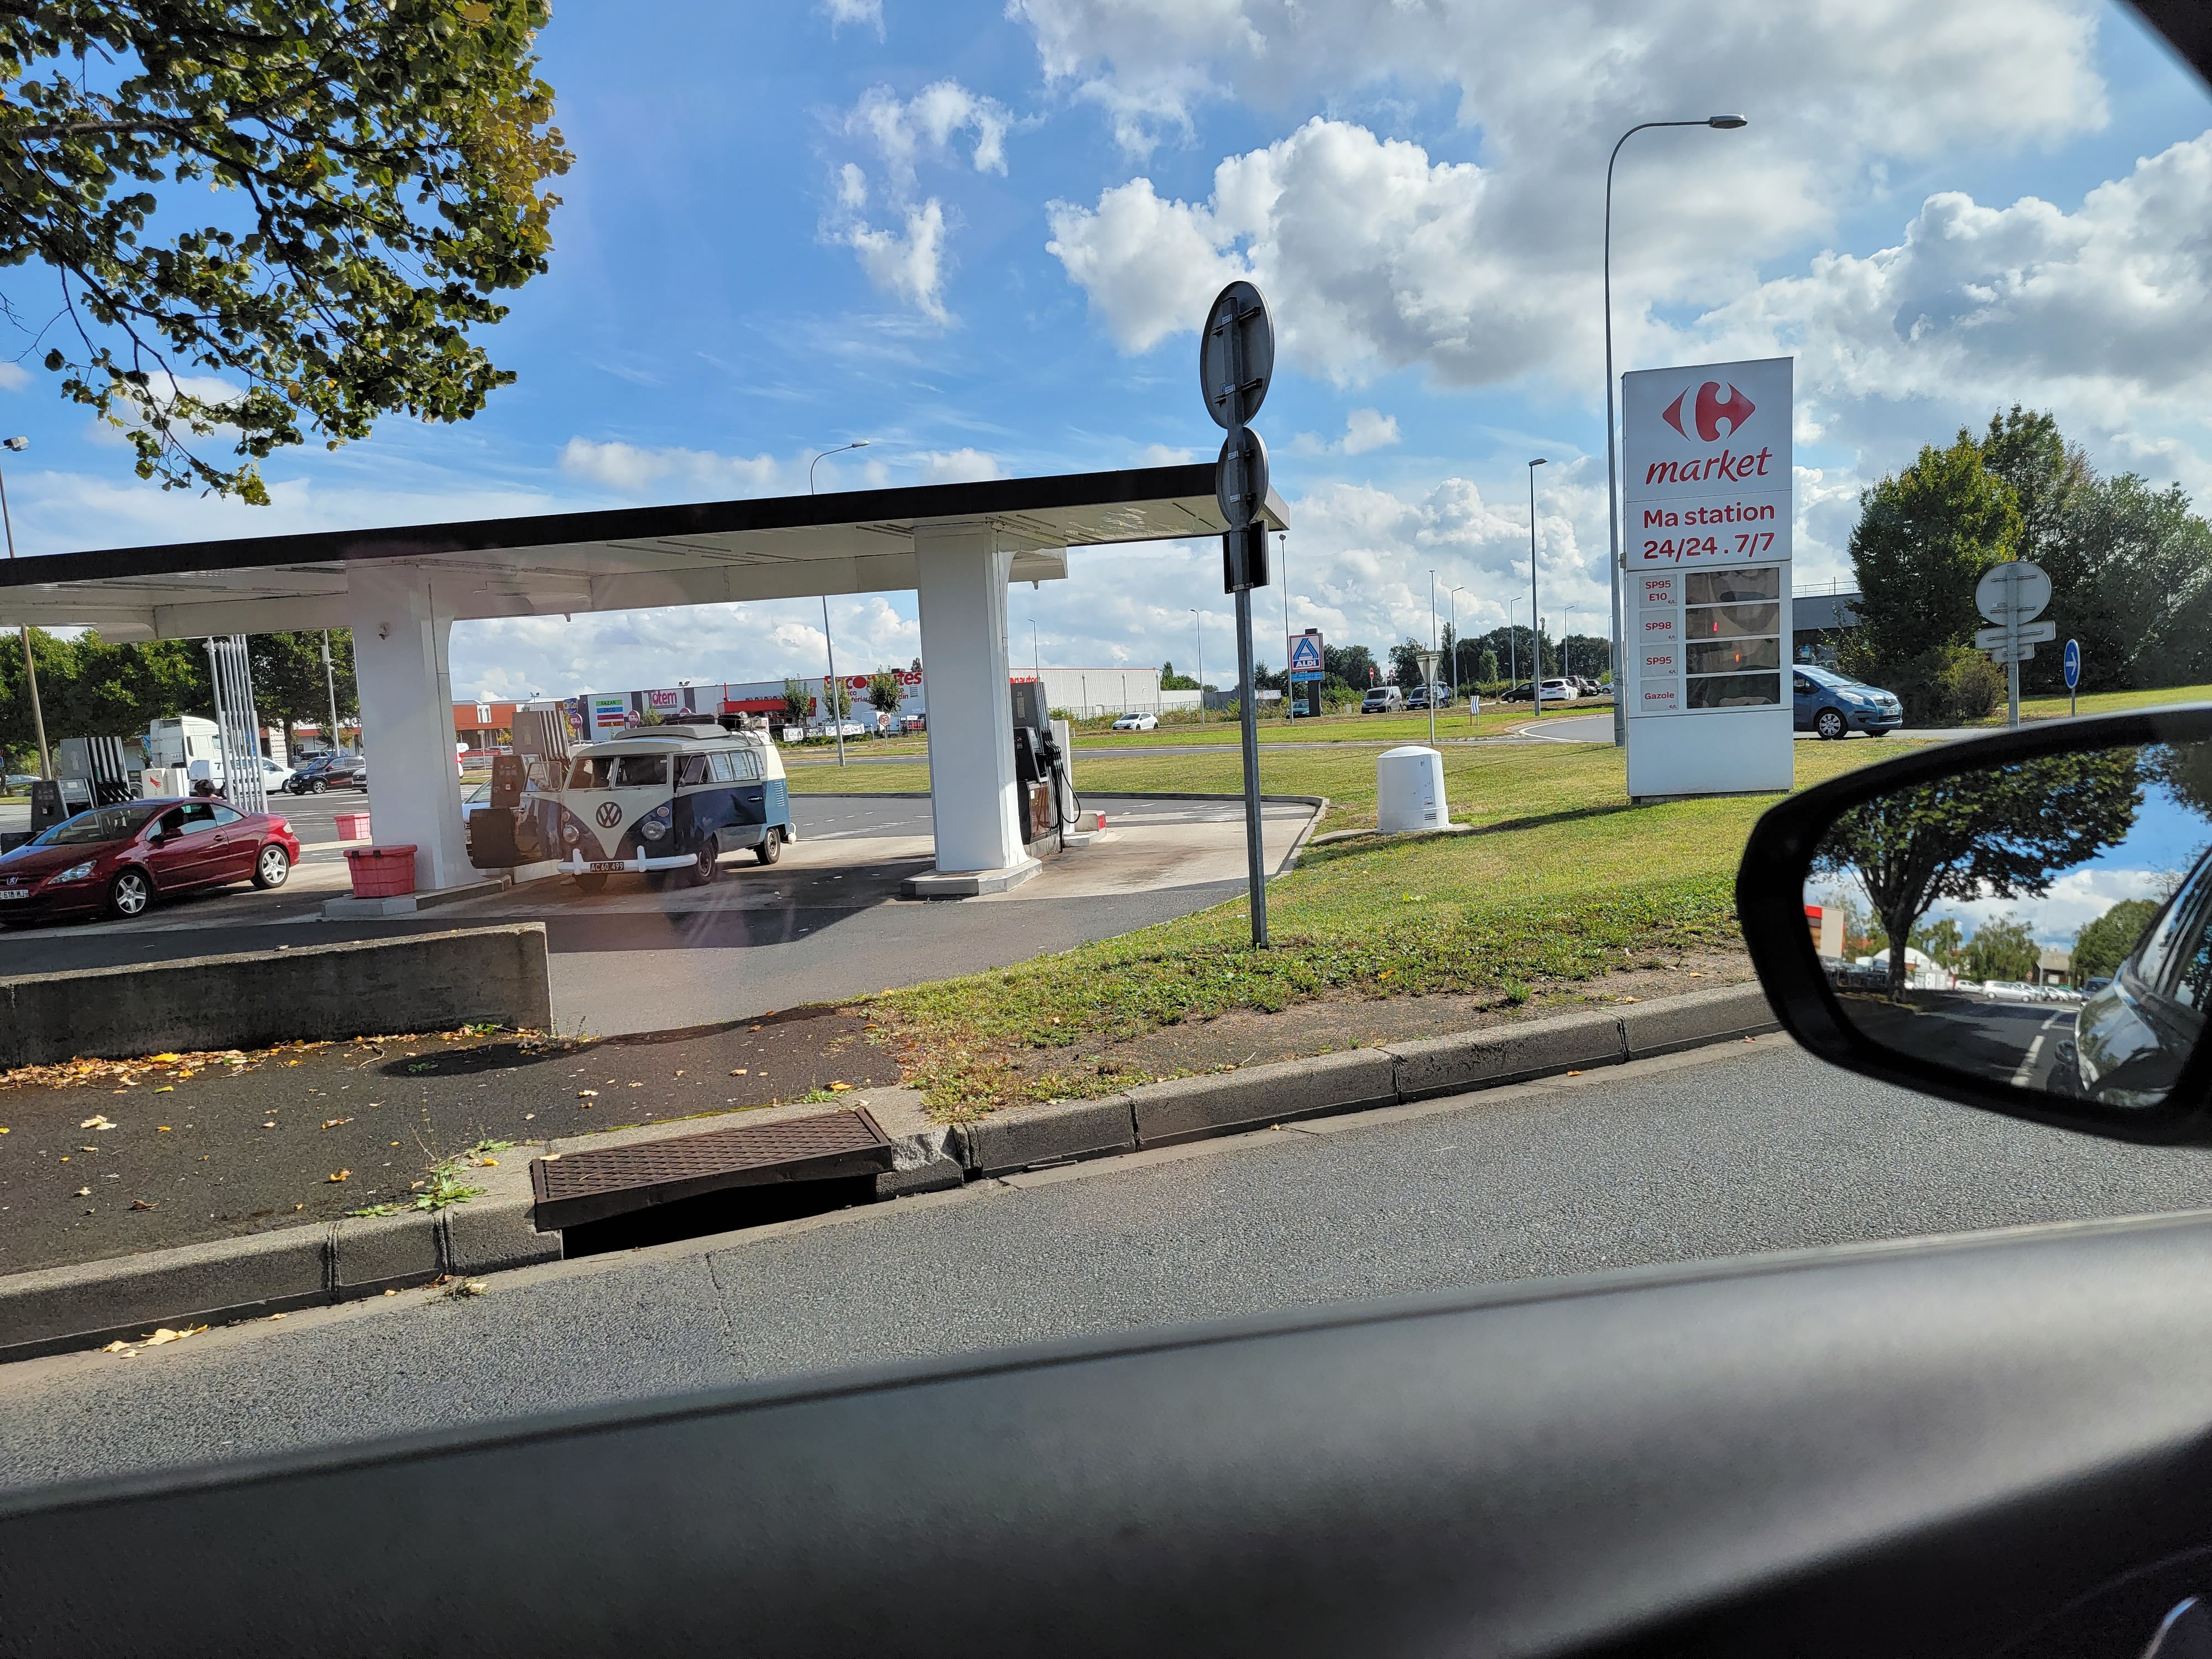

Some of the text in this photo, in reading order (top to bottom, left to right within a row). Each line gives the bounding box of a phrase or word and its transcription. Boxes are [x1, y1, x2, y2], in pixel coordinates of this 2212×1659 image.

[1646, 446, 1773, 485] market
[1644, 502, 1775, 529] Ma station
[1645, 580, 1671, 589] SP95
[1649, 592, 1667, 602] E10
[1645, 621, 1672, 631] SP98
[1646, 656, 1672, 665] SP95
[1644, 691, 1675, 700] Gazole
